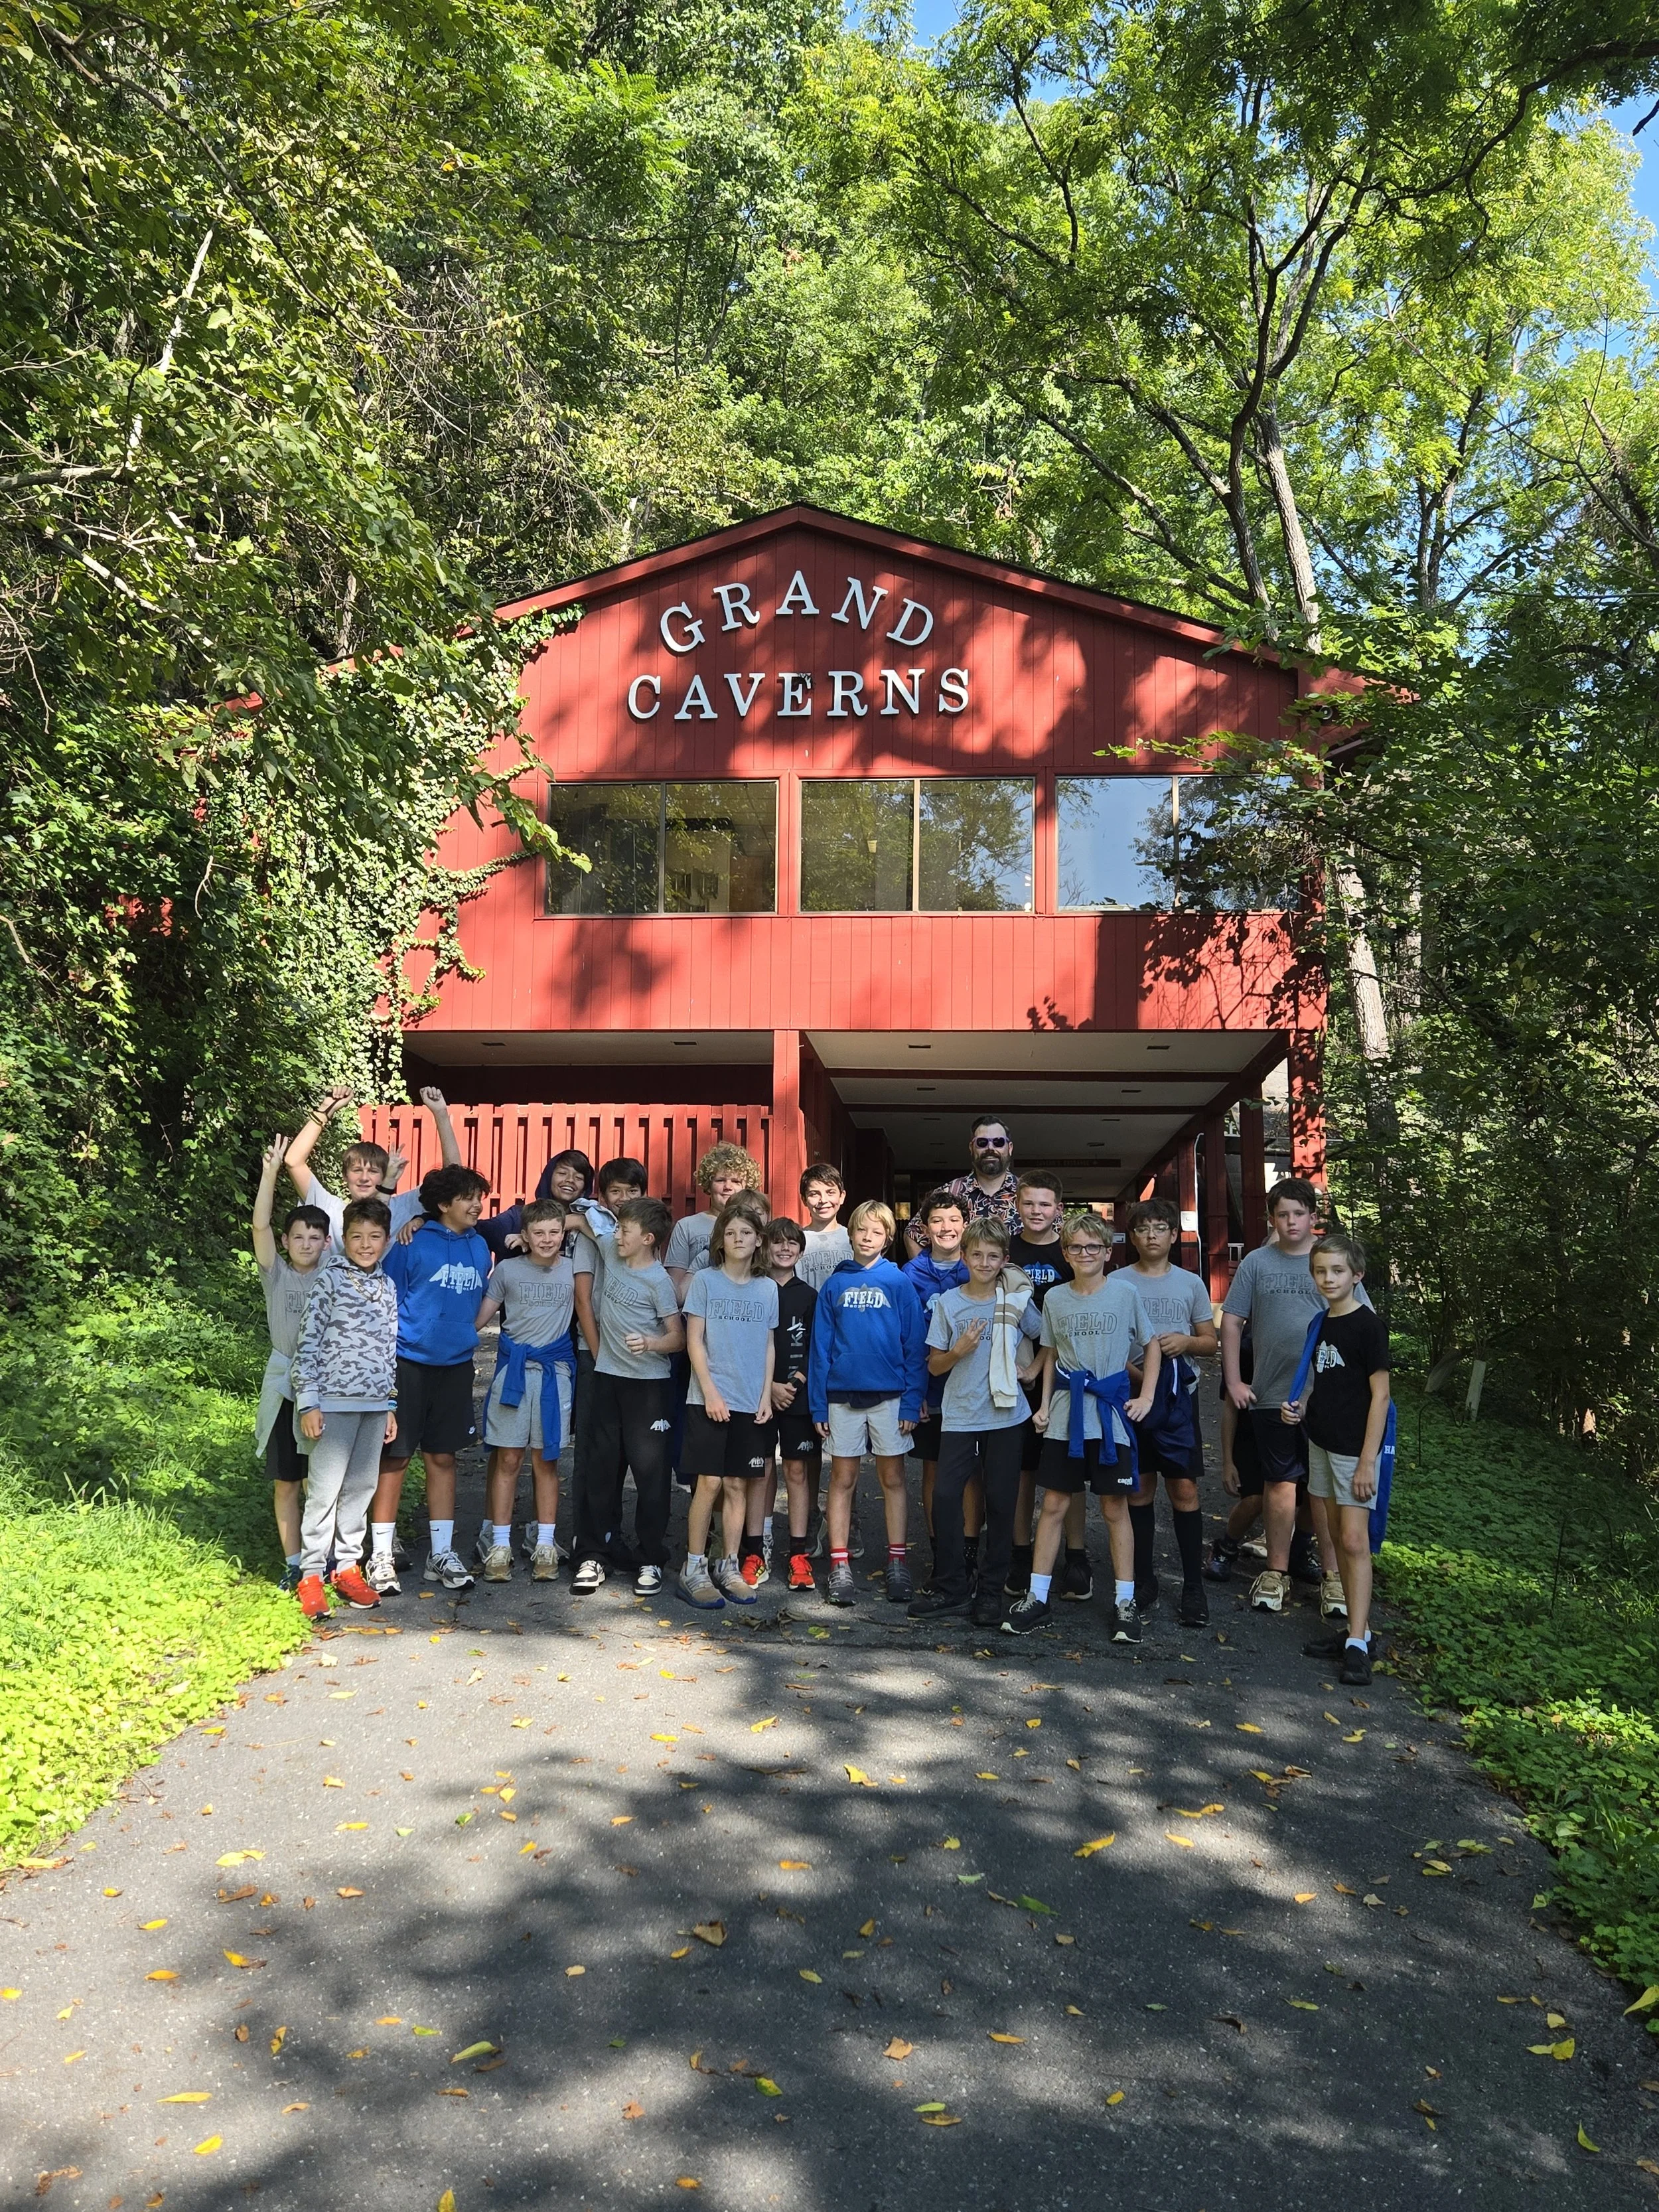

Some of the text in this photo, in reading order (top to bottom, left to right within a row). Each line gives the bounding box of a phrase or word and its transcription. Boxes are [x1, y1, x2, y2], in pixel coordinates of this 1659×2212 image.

[660, 570, 934, 653] GRAND
[627, 668, 970, 719] CAVERNS
[519, 1282, 573, 1307] FIELD
[1261, 1273, 1313, 1295] FIEL
[708, 1298, 765, 1323] FIELD
[843, 1291, 884, 1309] FIELD
